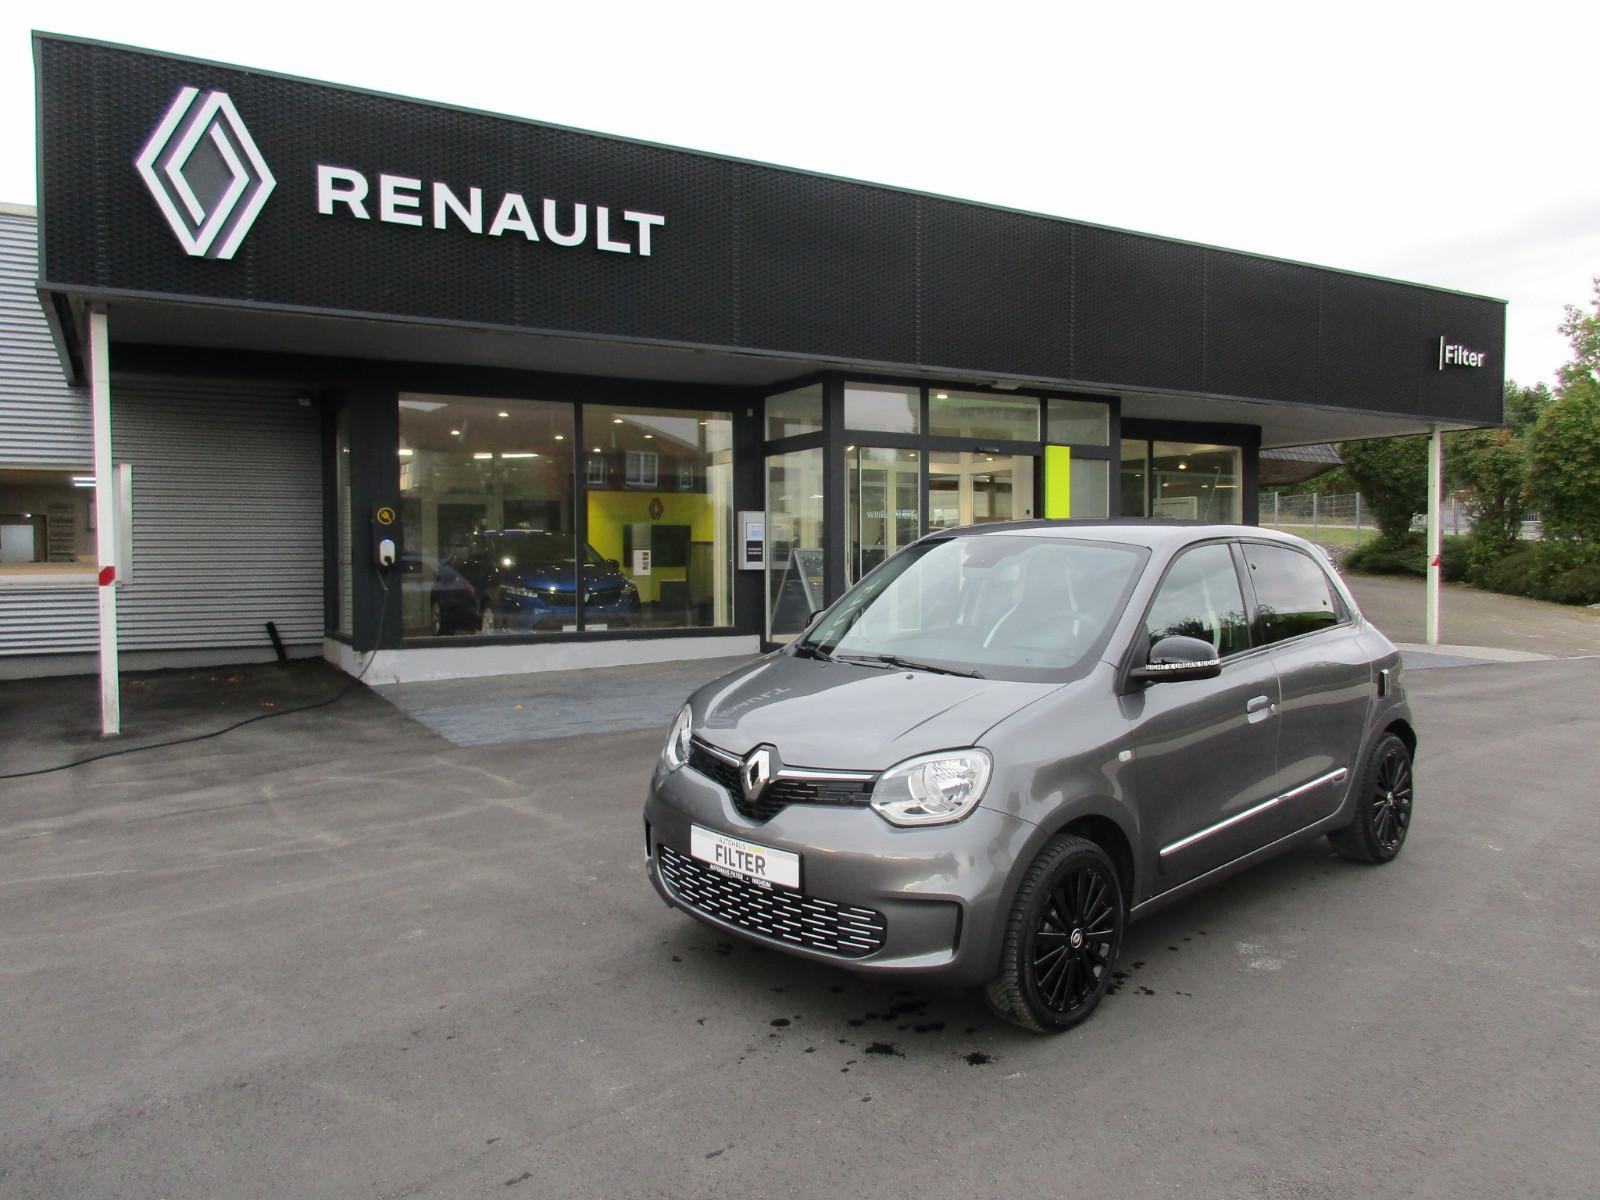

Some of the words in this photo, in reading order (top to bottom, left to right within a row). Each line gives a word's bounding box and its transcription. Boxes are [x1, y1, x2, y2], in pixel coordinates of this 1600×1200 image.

[317, 164, 665, 257] RENAULT
[1445, 344, 1484, 367] Filter
[715, 844, 766, 875] FILTER
